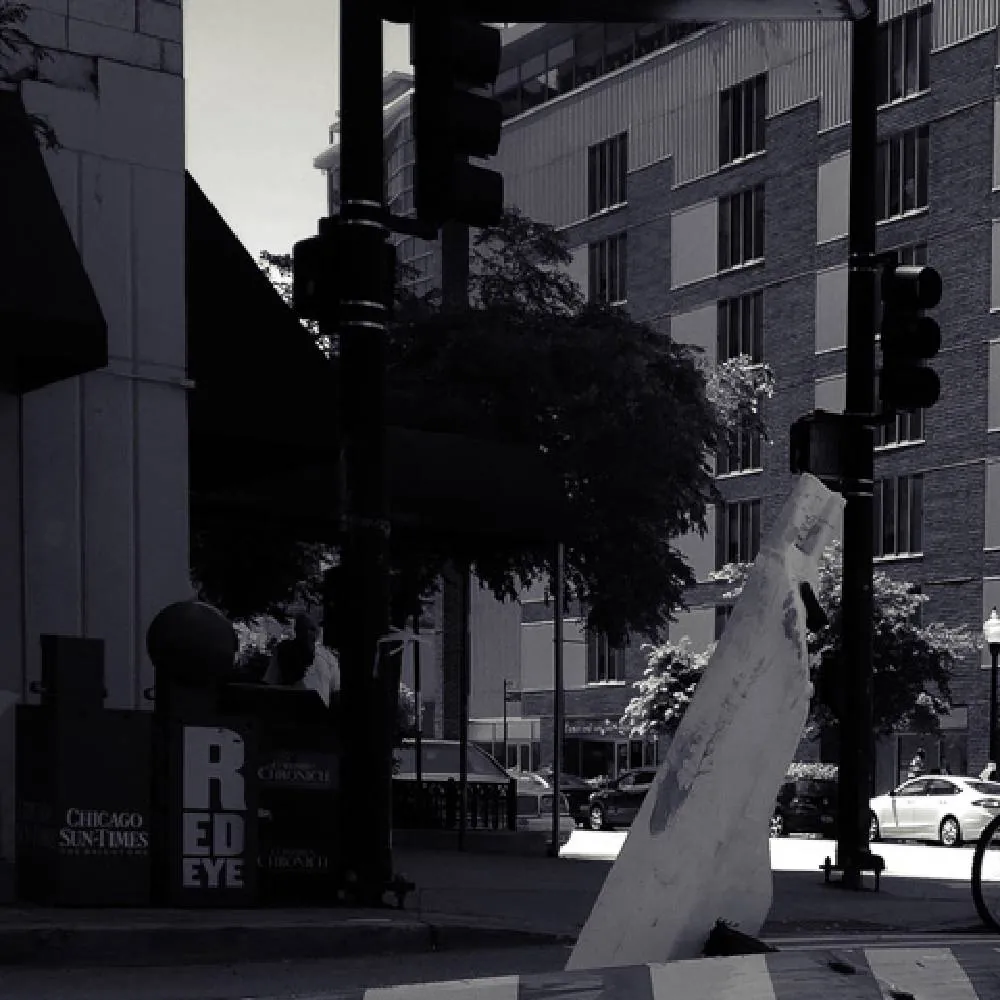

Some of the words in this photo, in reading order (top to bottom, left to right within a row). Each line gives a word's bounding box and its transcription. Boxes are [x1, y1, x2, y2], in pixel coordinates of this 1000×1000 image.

[66, 808, 143, 828] CHICAGO
[58, 828, 149, 849] SUN-TIMES
[183, 858, 245, 888] EYE
